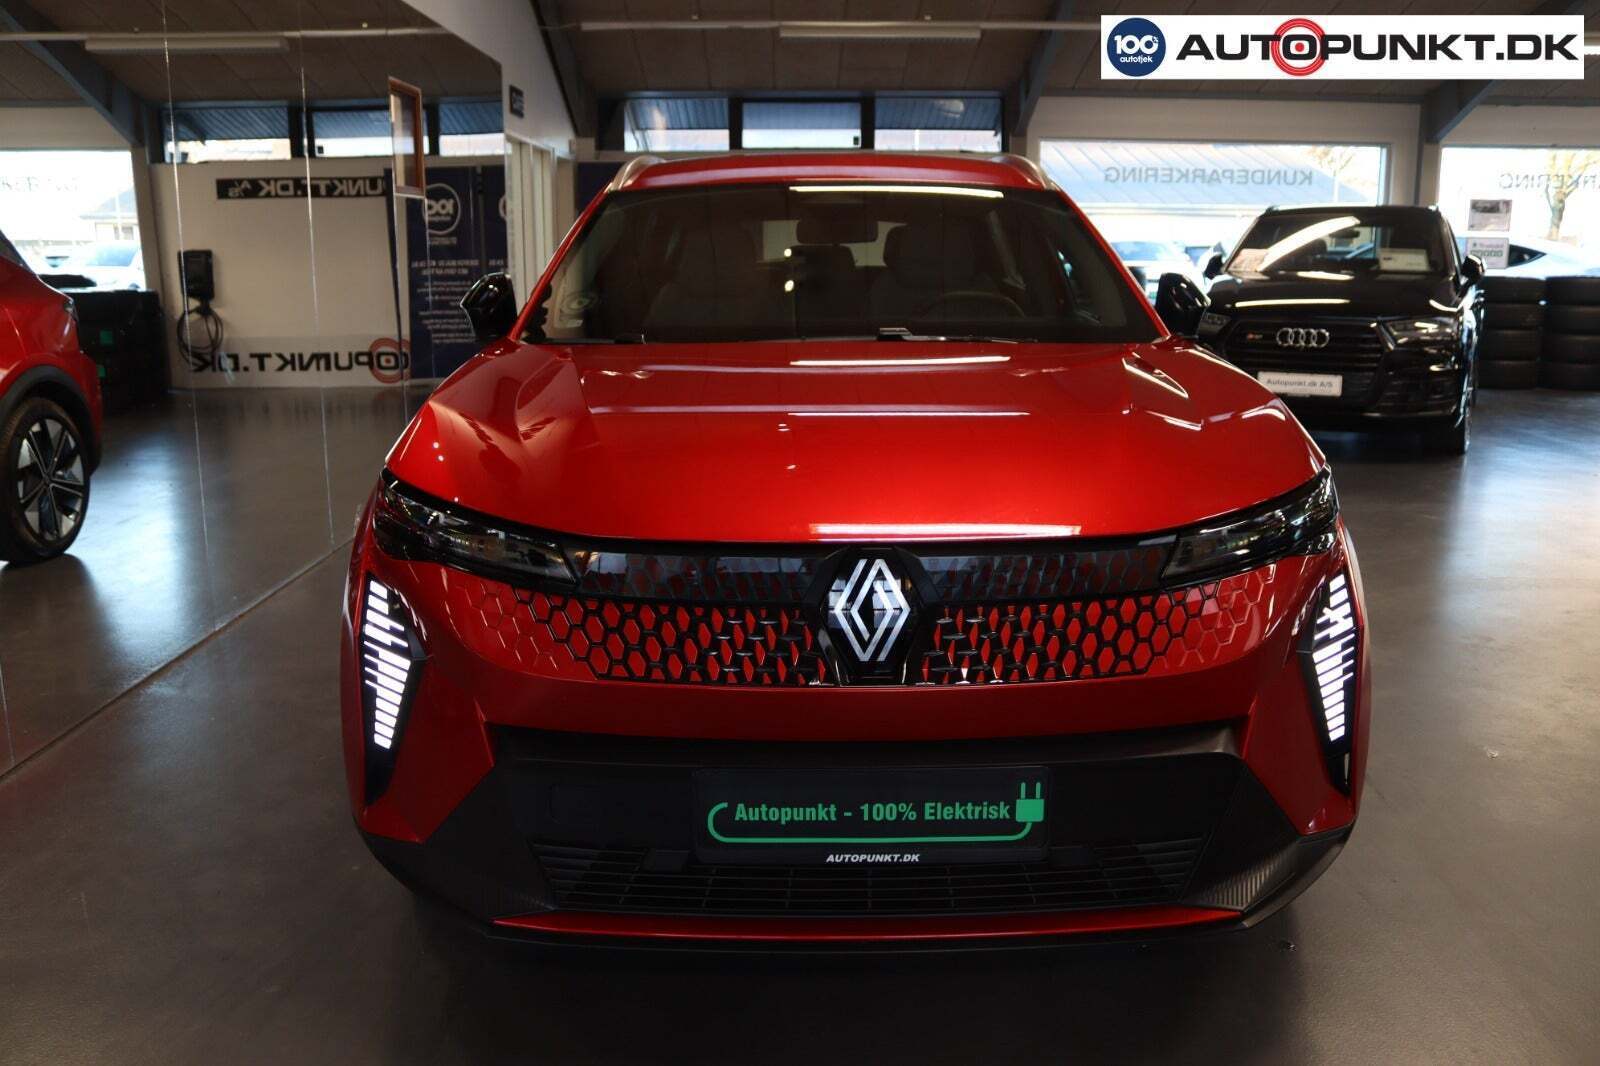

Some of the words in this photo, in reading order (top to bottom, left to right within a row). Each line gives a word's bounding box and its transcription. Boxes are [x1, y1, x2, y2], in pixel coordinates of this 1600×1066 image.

[1266, 378, 1317, 388] Autopunkt.dk
[735, 804, 837, 823] Autopunkt
[861, 803, 917, 821] 100%
[923, 802, 1010, 821] Elektrisk
[825, 853, 920, 863] AUTOPUNKT.DK
